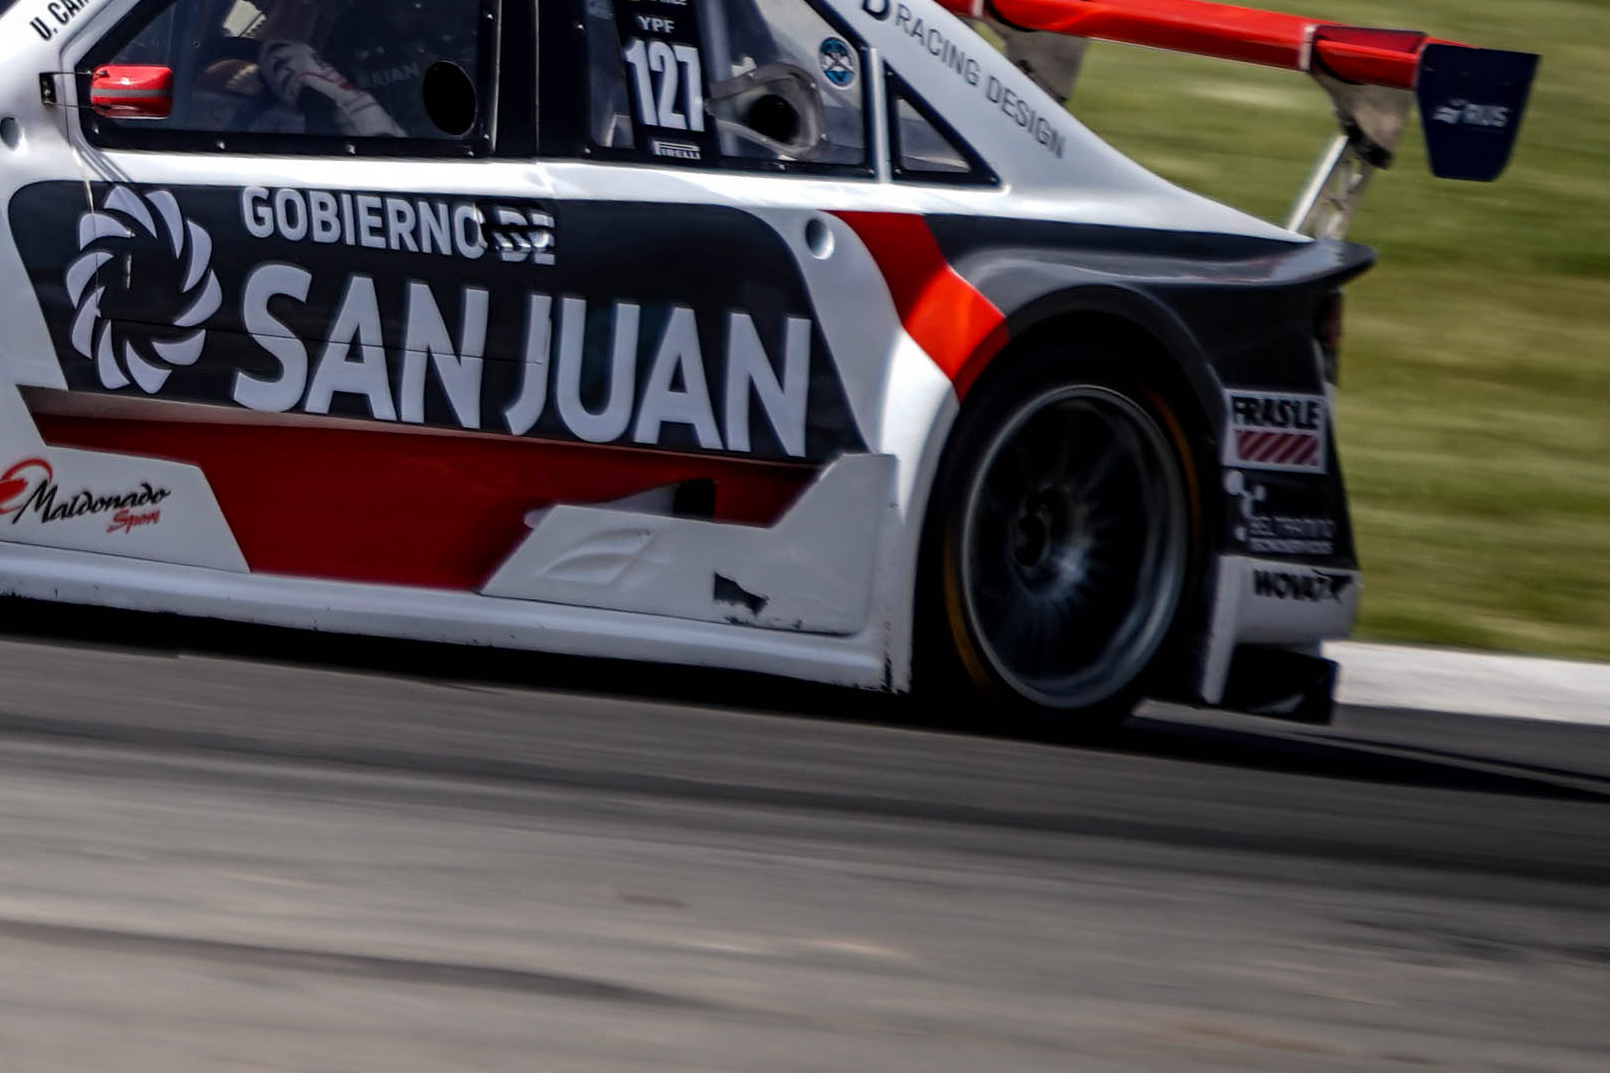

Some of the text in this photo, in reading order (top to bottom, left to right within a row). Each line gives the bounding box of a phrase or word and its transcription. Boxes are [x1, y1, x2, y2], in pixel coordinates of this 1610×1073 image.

[28, 16, 55, 43] U.
[637, 15, 676, 34] YPF
[625, 38, 705, 133] 127
[895, 3, 982, 87] RACING
[985, 74, 1068, 160] DESIGN
[652, 140, 702, 160] PIRELLI
[242, 185, 489, 260] GOBIERNO
[232, 262, 813, 458] SAN JUAN
[11, 479, 172, 525] Maldonado
[105, 508, 161, 535] Sport
